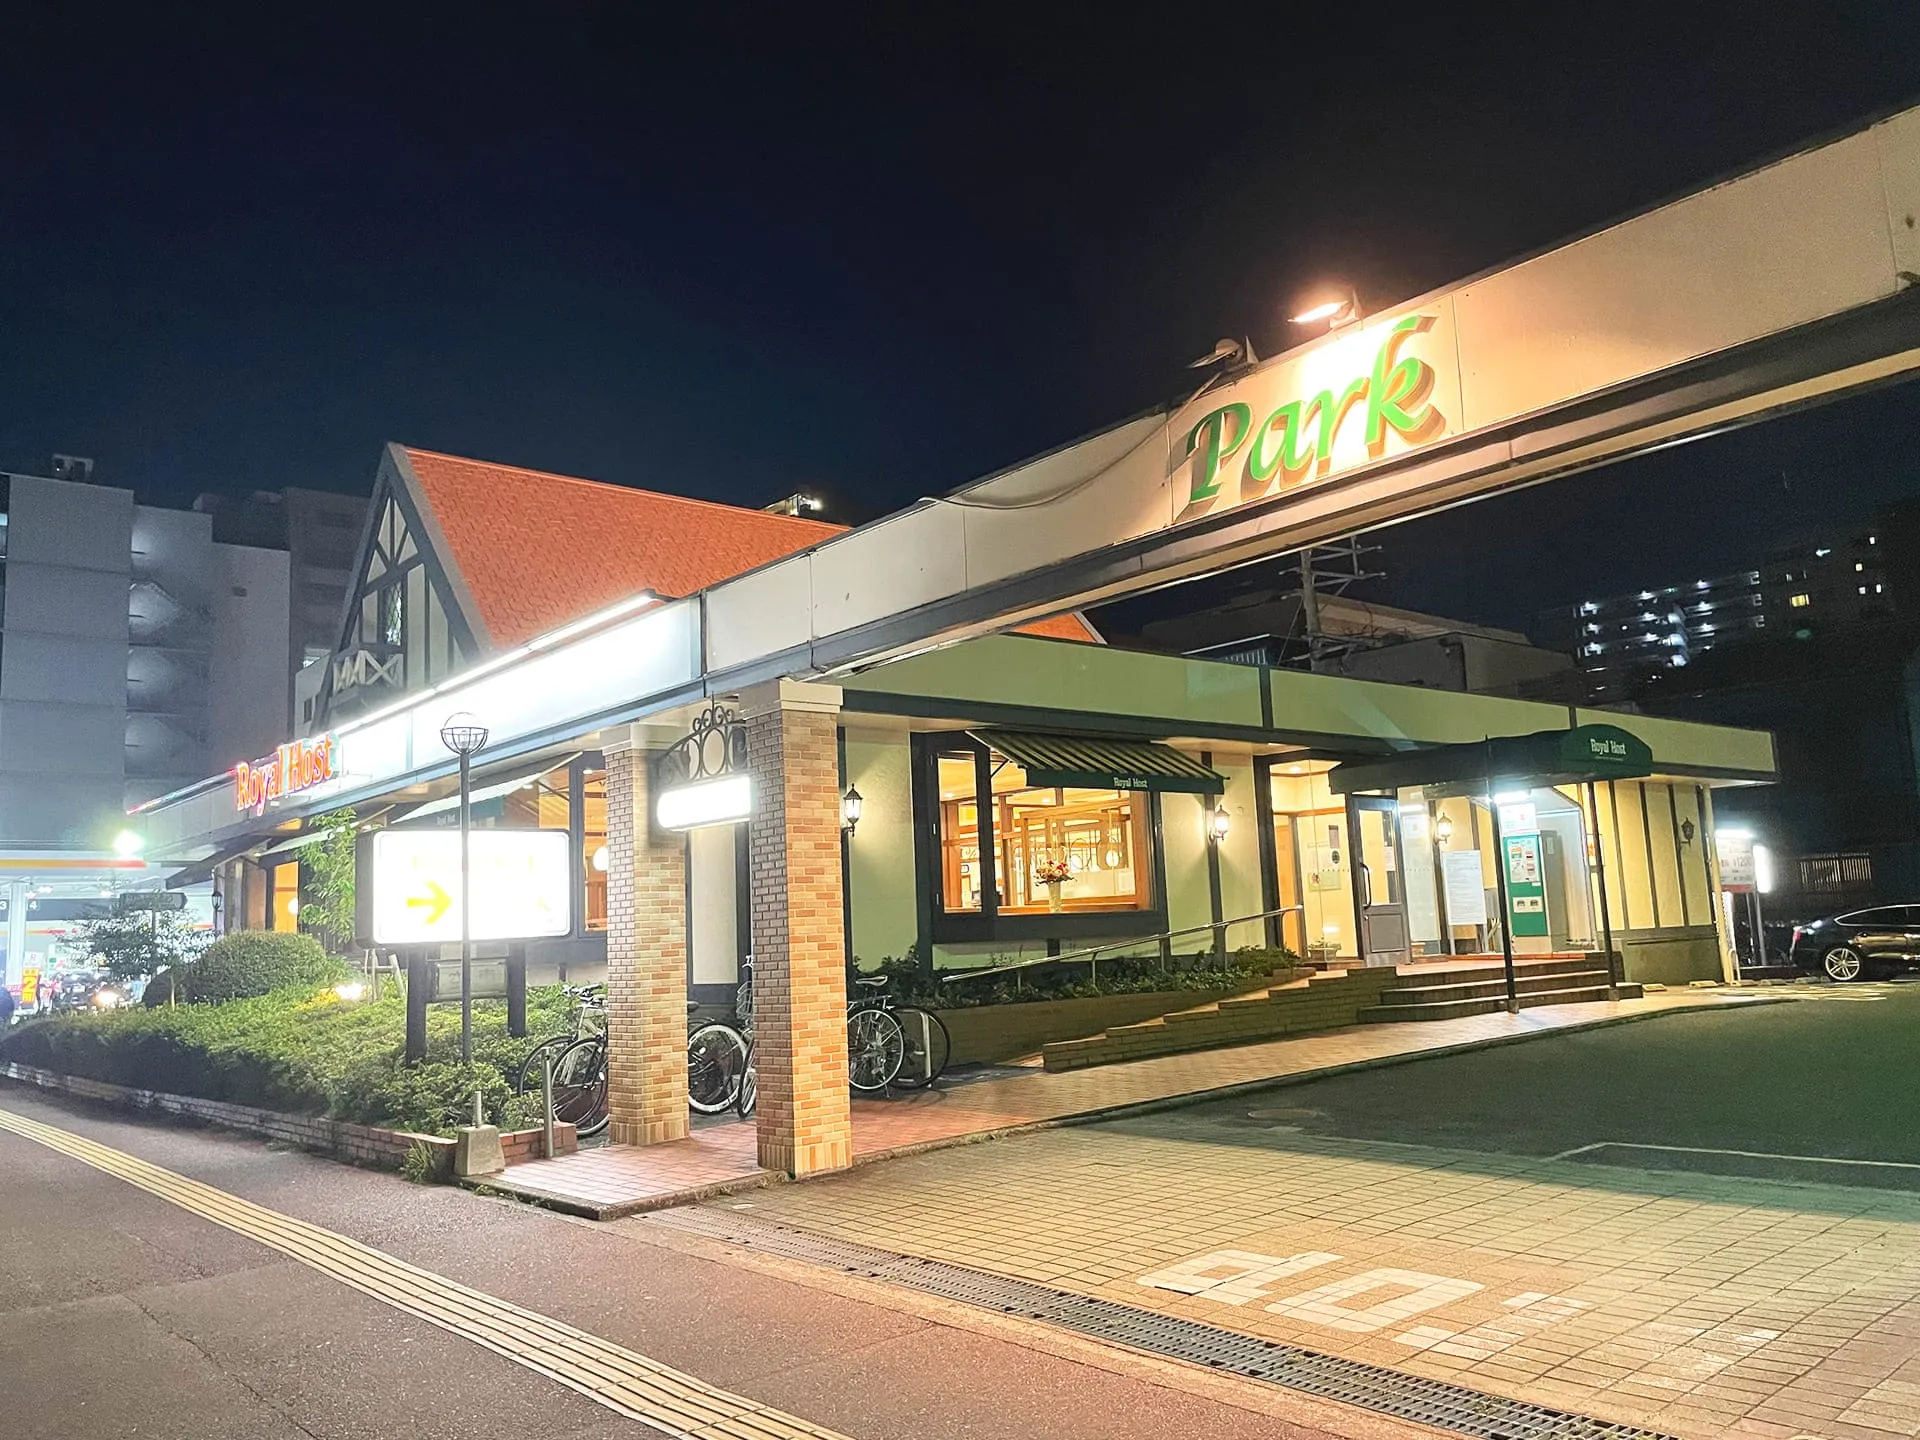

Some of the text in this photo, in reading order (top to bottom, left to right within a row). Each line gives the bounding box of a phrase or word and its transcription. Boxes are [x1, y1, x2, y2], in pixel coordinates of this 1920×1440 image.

[1184, 314, 1440, 506] Park
[1590, 738, 1627, 755] Royal Host
[236, 732, 333, 817] Royal Host
[1113, 777, 1132, 788] Royal
[29, 901, 38, 910] 4
